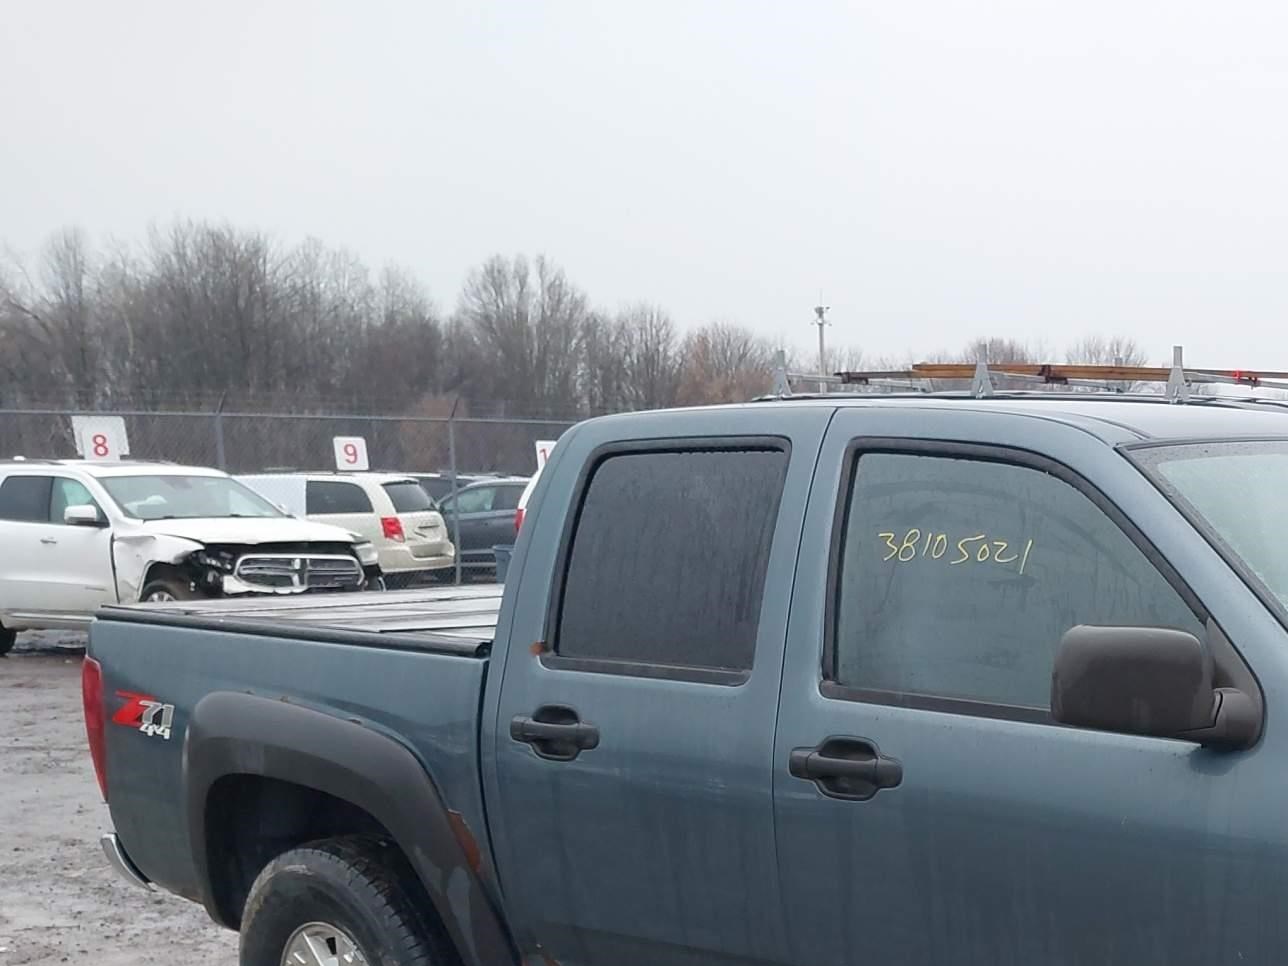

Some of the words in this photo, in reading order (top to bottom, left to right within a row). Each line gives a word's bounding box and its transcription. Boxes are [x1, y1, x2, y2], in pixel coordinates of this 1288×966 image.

[92, 433, 109, 457] 8
[343, 443, 359, 465] 9
[878, 528, 1033, 575] 38105021
[111, 688, 175, 728] Z71
